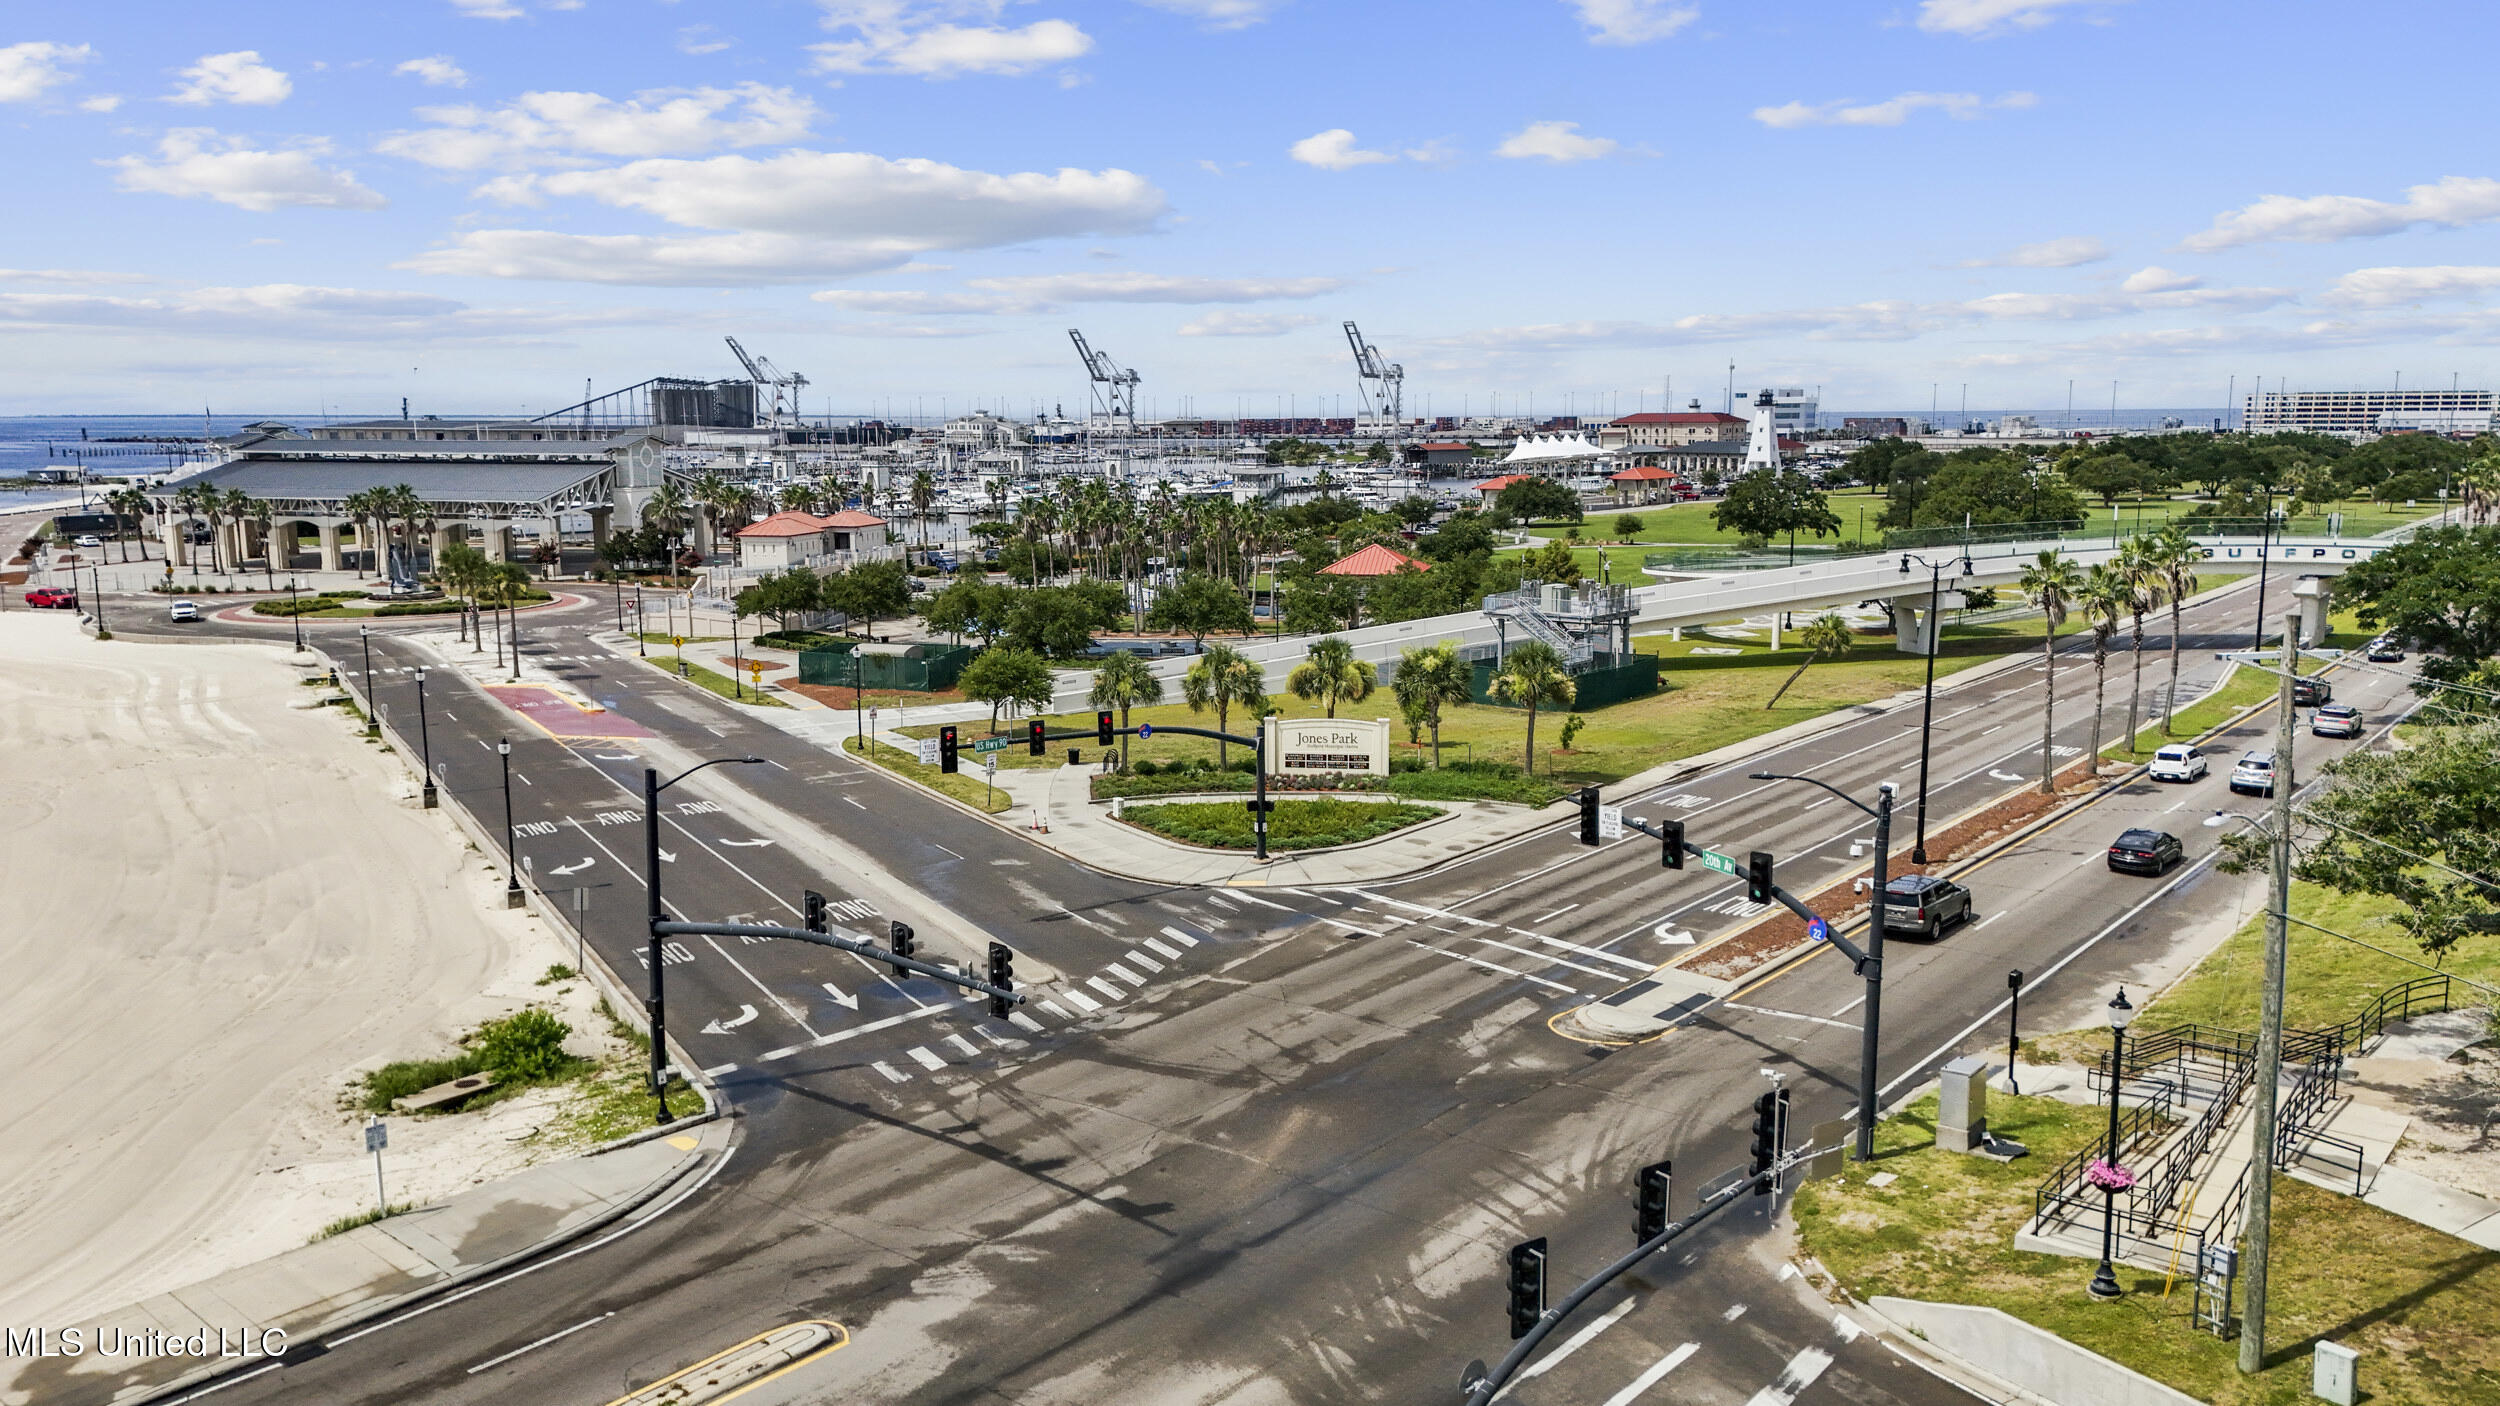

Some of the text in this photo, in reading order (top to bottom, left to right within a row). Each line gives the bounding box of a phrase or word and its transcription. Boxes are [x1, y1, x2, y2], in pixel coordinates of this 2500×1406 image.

[2200, 548, 2378, 560] GULFPO
[976, 738, 1007, 751] US Hwy 90
[1296, 732, 1358, 746] Jones Park
[676, 800, 722, 816] ONLY
[595, 809, 642, 826] ONLY
[511, 820, 558, 838] ONLY
[1705, 853, 1733, 873] 20th Av
[824, 899, 882, 922] ONLY
[1813, 928, 1822, 940] 22
